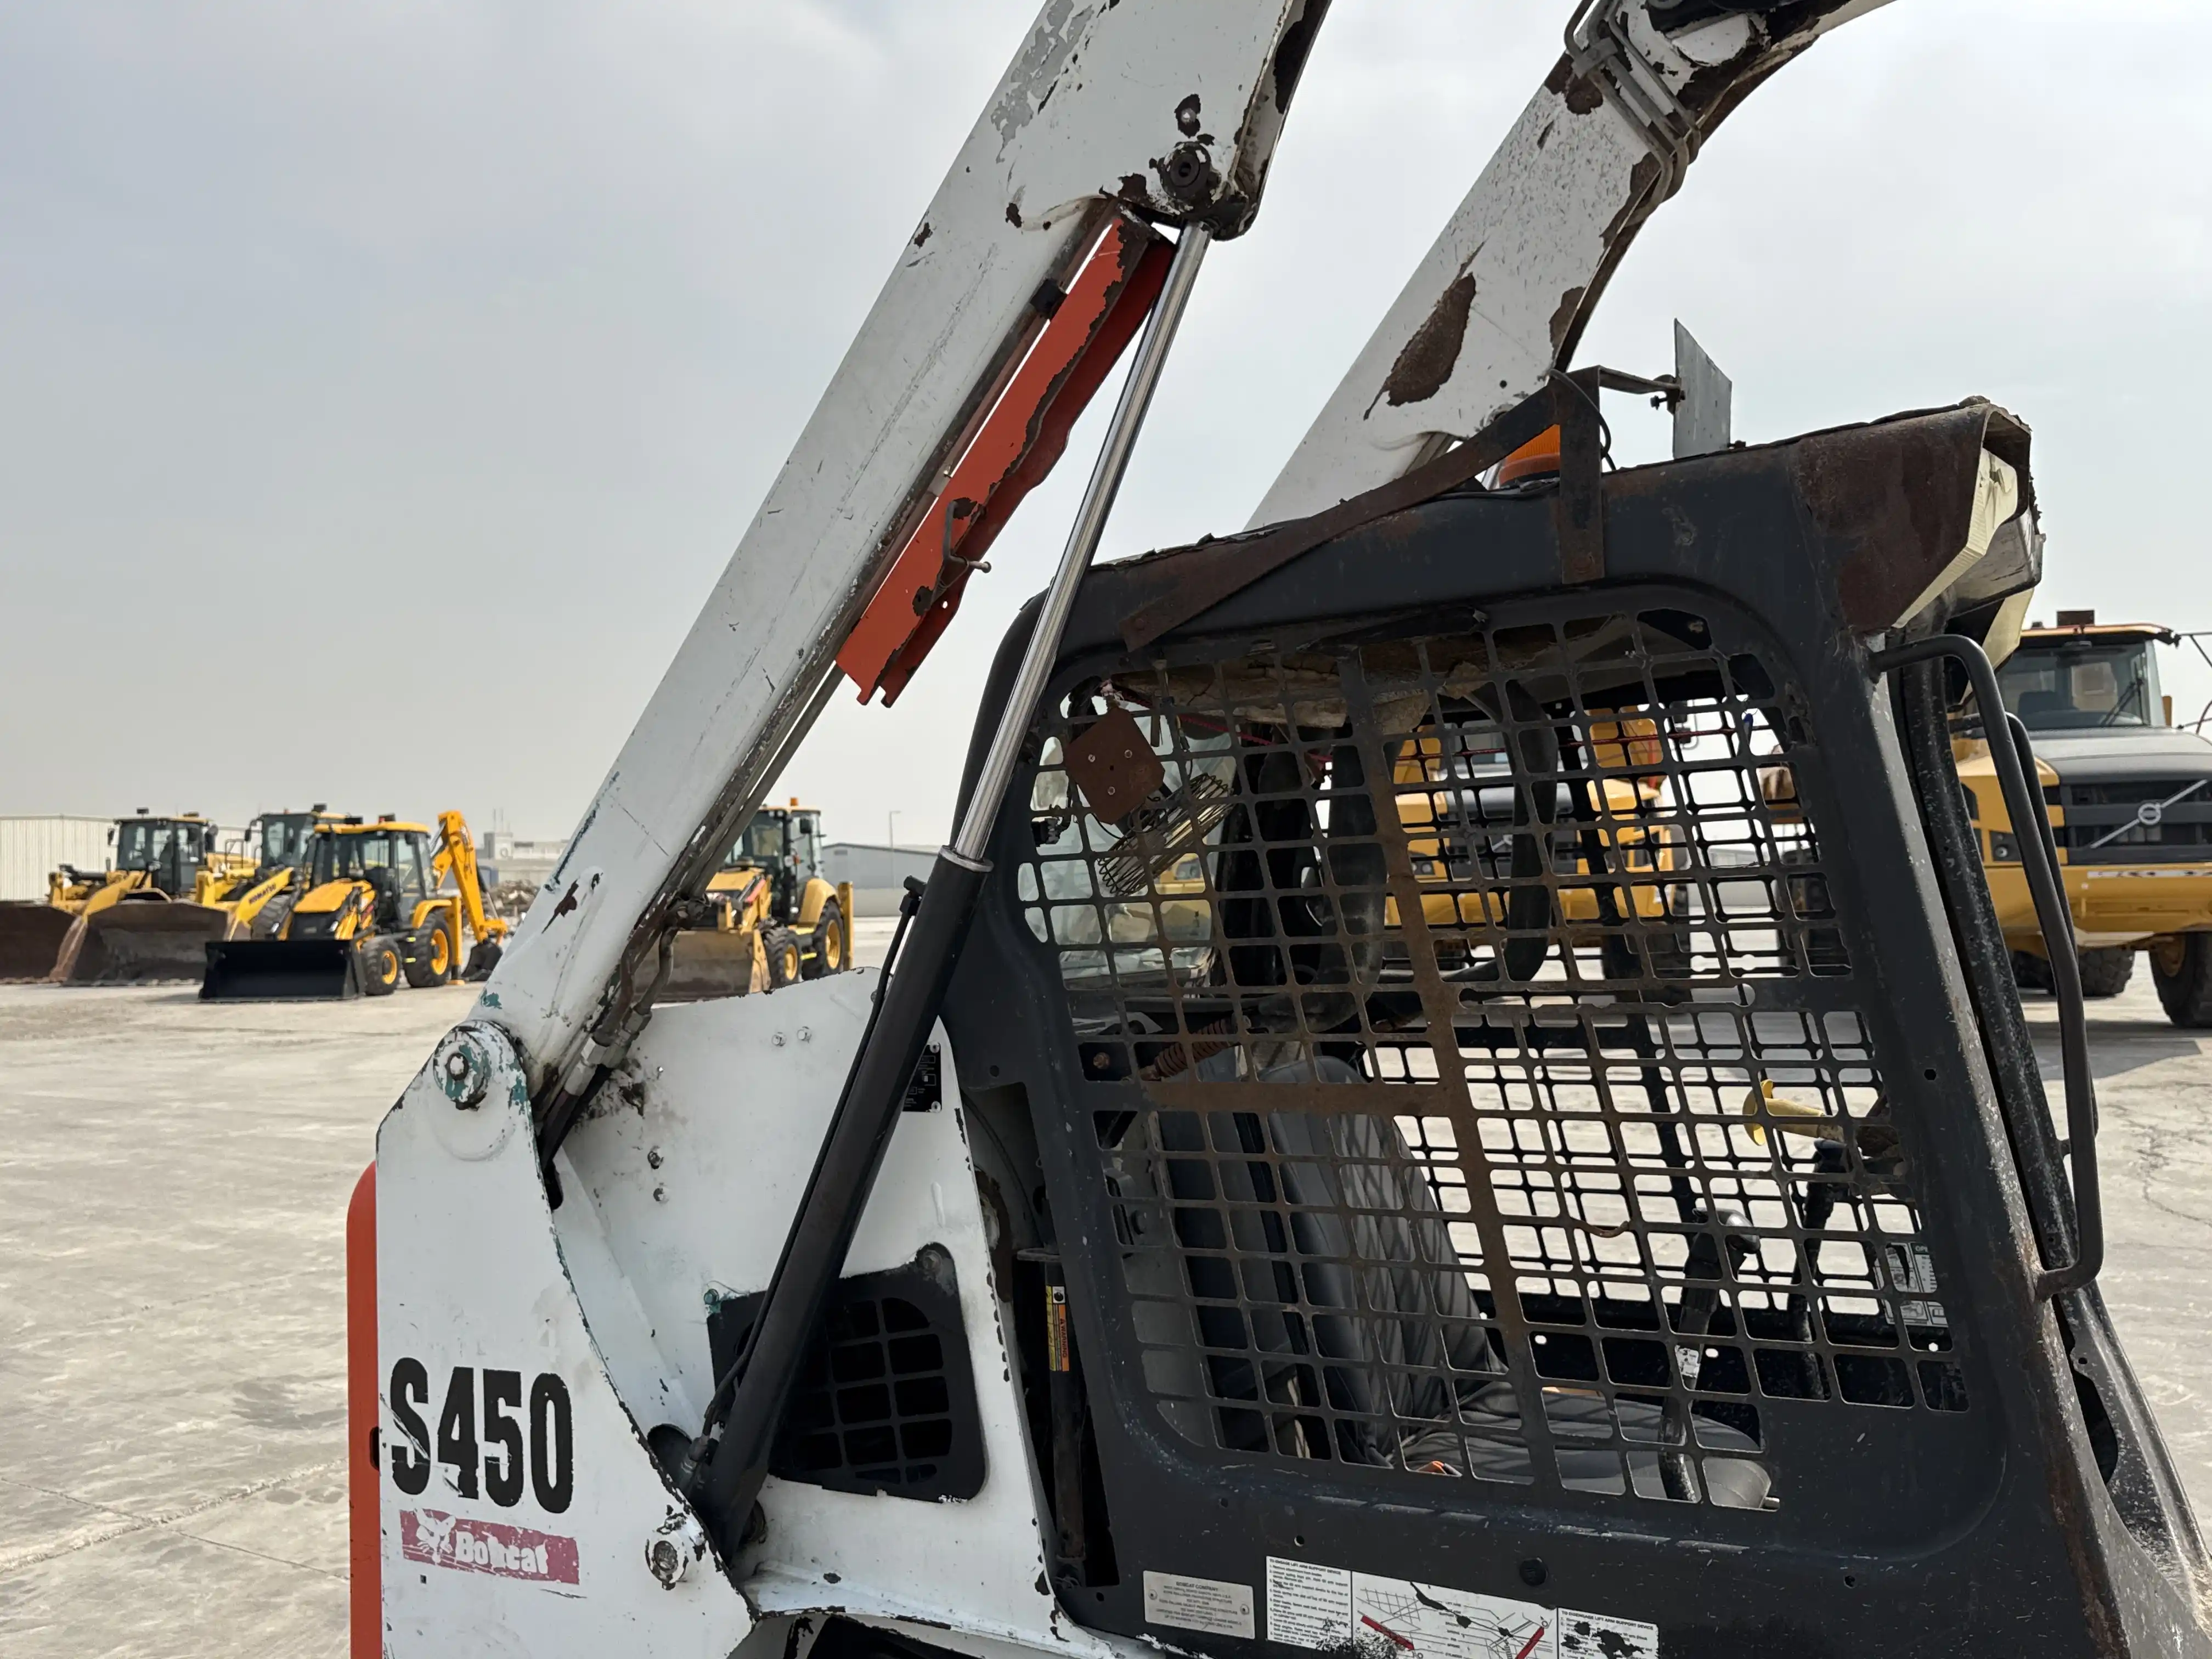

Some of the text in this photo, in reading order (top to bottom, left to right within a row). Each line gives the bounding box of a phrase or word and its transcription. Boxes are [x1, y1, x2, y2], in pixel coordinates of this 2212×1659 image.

[1060, 1326, 1068, 1358] WARNING
[390, 1357, 574, 1514] S450
[454, 1530, 549, 1575] Bobcat
